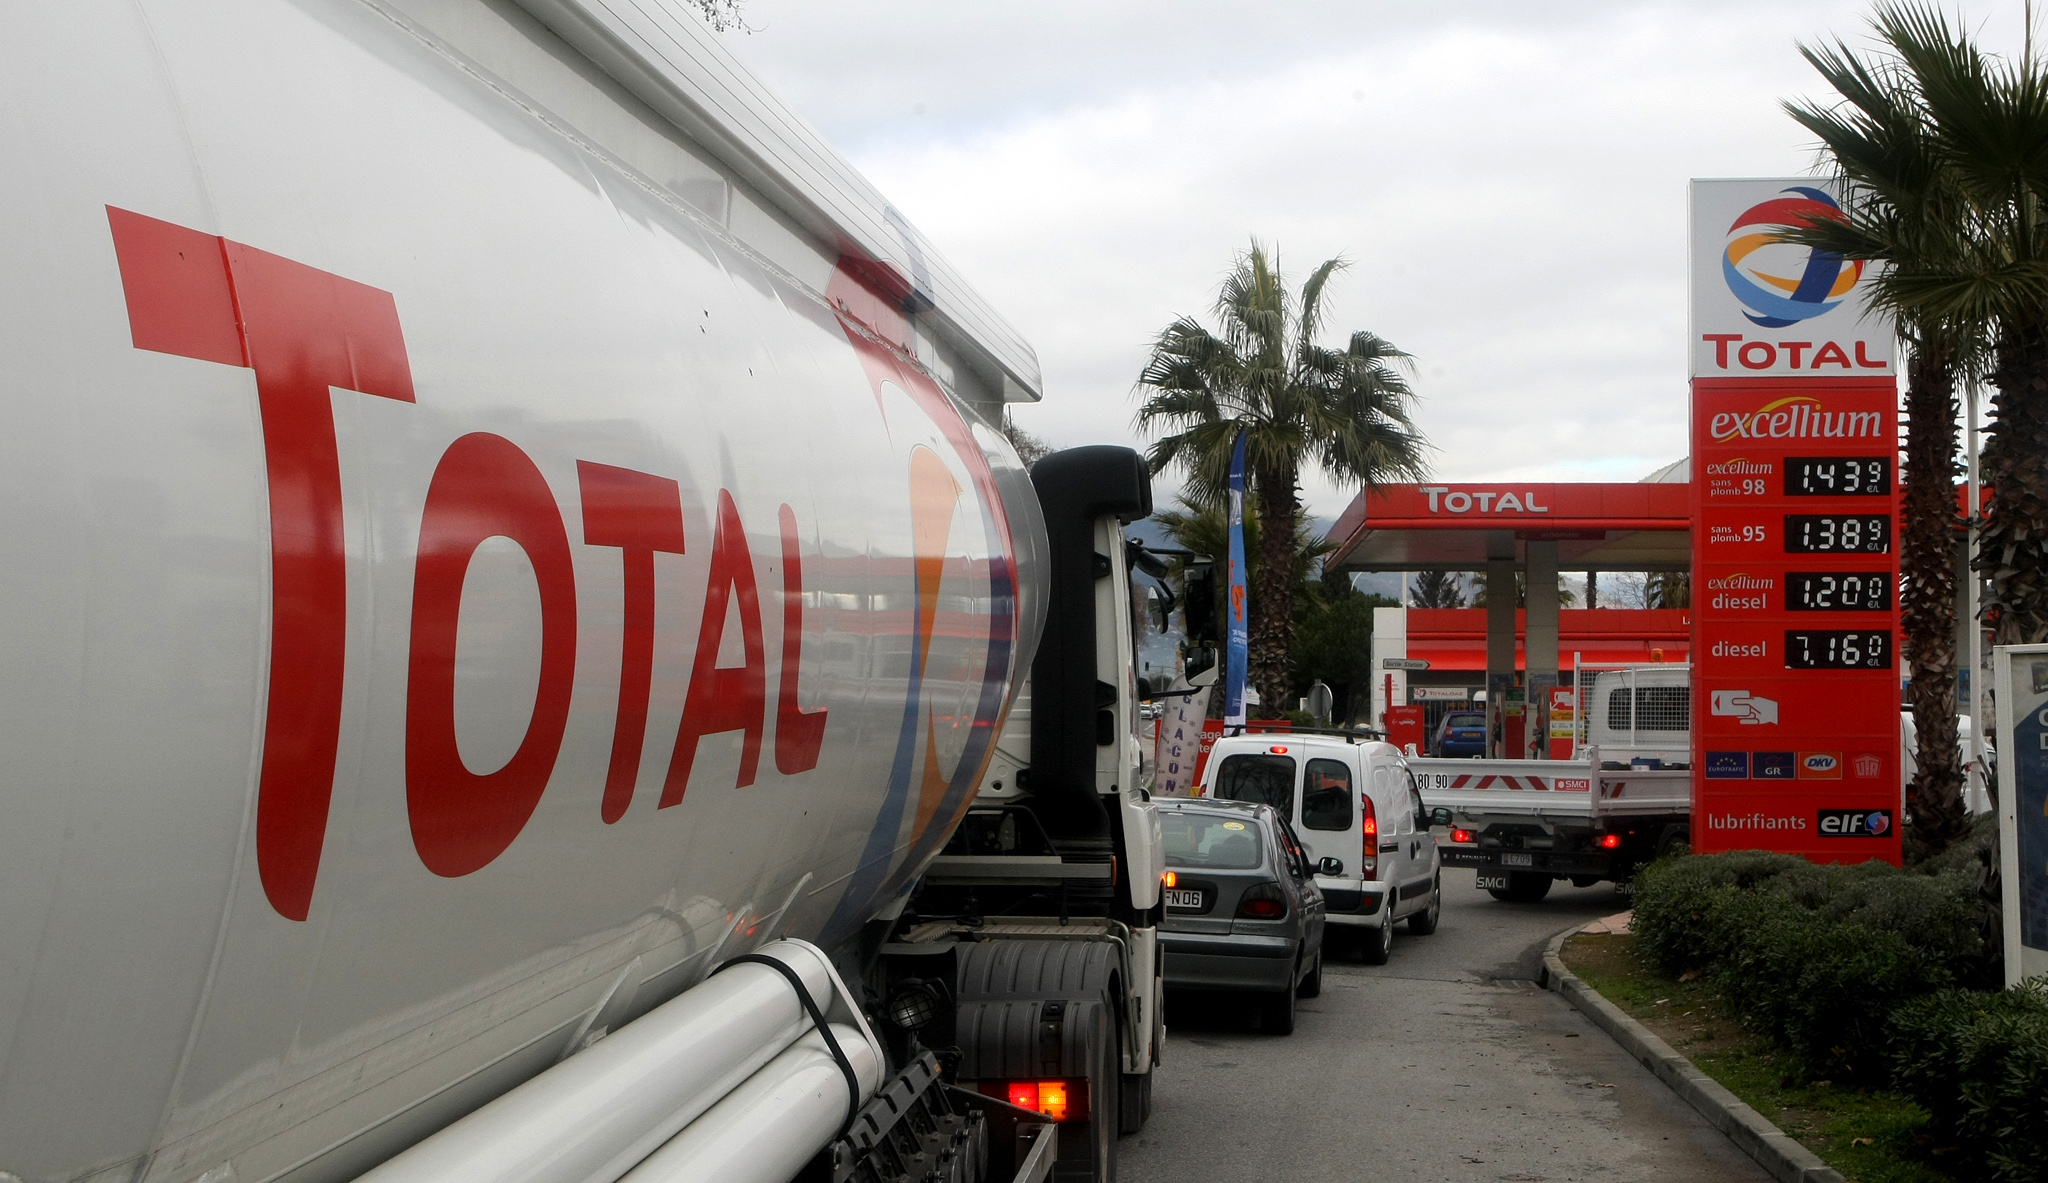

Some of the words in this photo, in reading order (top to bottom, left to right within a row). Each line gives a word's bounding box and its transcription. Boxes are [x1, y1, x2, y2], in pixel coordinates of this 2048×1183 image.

[1702, 333, 1888, 370] TOTAL
[1710, 400, 1882, 440] excellium
[1706, 460, 1773, 475] excellium
[1710, 479, 1732, 487] sans
[1710, 487, 1741, 497] plomb
[1742, 478, 1766, 495] 98
[1419, 486, 1549, 513] TOTAL
[1710, 534, 1741, 544] plomb
[1742, 525, 1766, 542] 95
[105, 204, 828, 922] TOTAL
[1707, 575, 1774, 590] excellium
[1711, 593, 1767, 609] diesel
[1711, 640, 1767, 657] diesel
[1200, 731, 1222, 743] age
[1807, 757, 1833, 768] DKV
[1765, 767, 1781, 776] GR
[1435, 773, 1448, 789] 90
[1565, 780, 1587, 789] SMCI
[1708, 813, 1807, 830] lubrifiants
[1820, 813, 1864, 833] elf
[1476, 876, 1506, 889] SMCI
[1615, 882, 1636, 895] SM
[1182, 891, 1200, 905] 06
